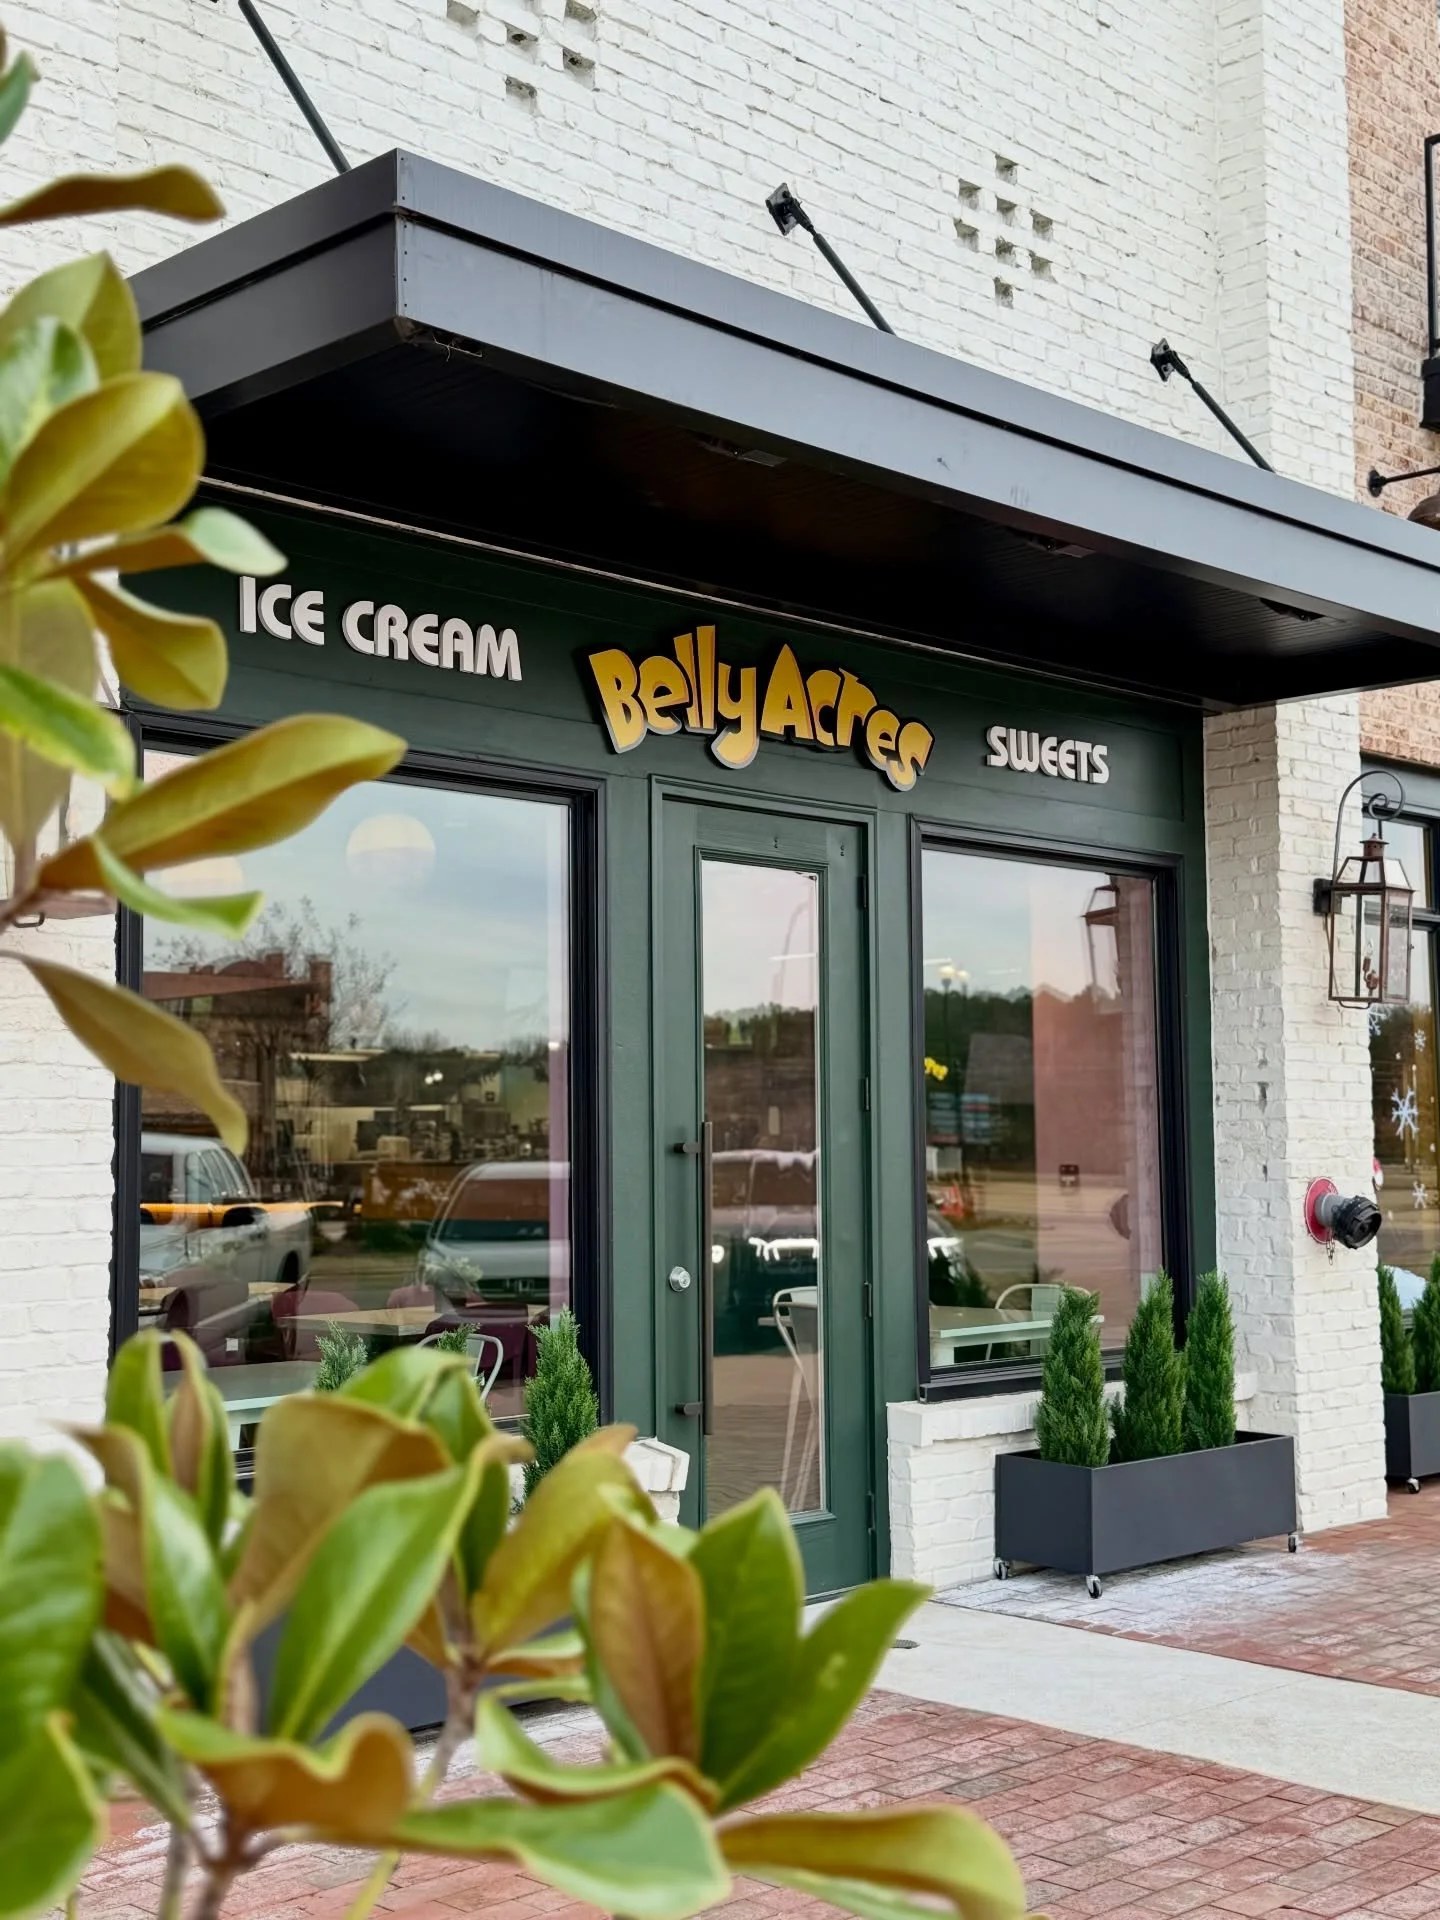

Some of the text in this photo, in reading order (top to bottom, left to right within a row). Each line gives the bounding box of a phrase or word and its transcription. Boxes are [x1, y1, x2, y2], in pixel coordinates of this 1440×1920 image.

[239, 576, 523, 681] ICE CREAM
[588, 624, 935, 792] Belly Acres
[986, 725, 1110, 783] SWEETS
